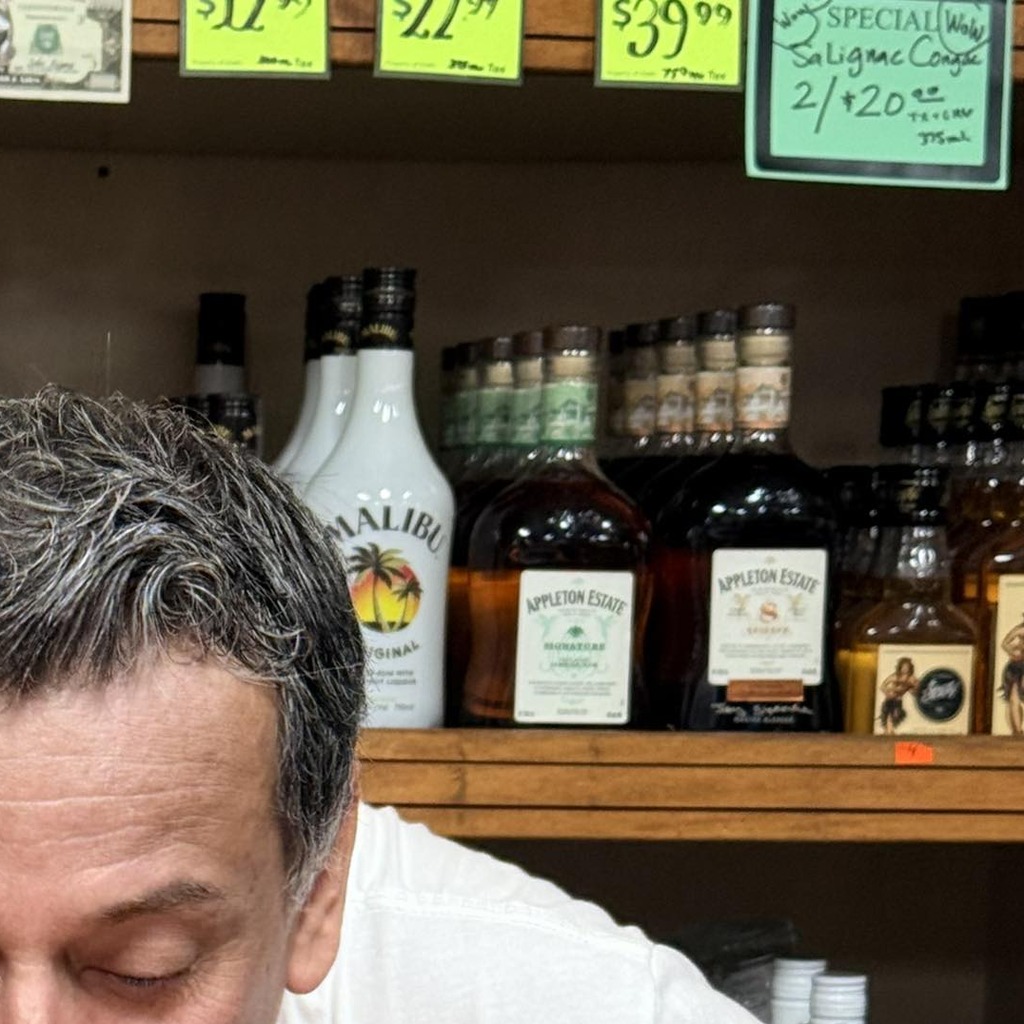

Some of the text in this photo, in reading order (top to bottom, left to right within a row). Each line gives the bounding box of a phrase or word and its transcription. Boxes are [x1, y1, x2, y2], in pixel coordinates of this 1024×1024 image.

[827, 6, 939, 32] SPECIAL
[324, 505, 444, 554] MALIBU
[719, 567, 820, 594] APPLETON ESTATE
[526, 589, 629, 616] APPLETON ESTATE
[372, 640, 420, 660] GINAL
